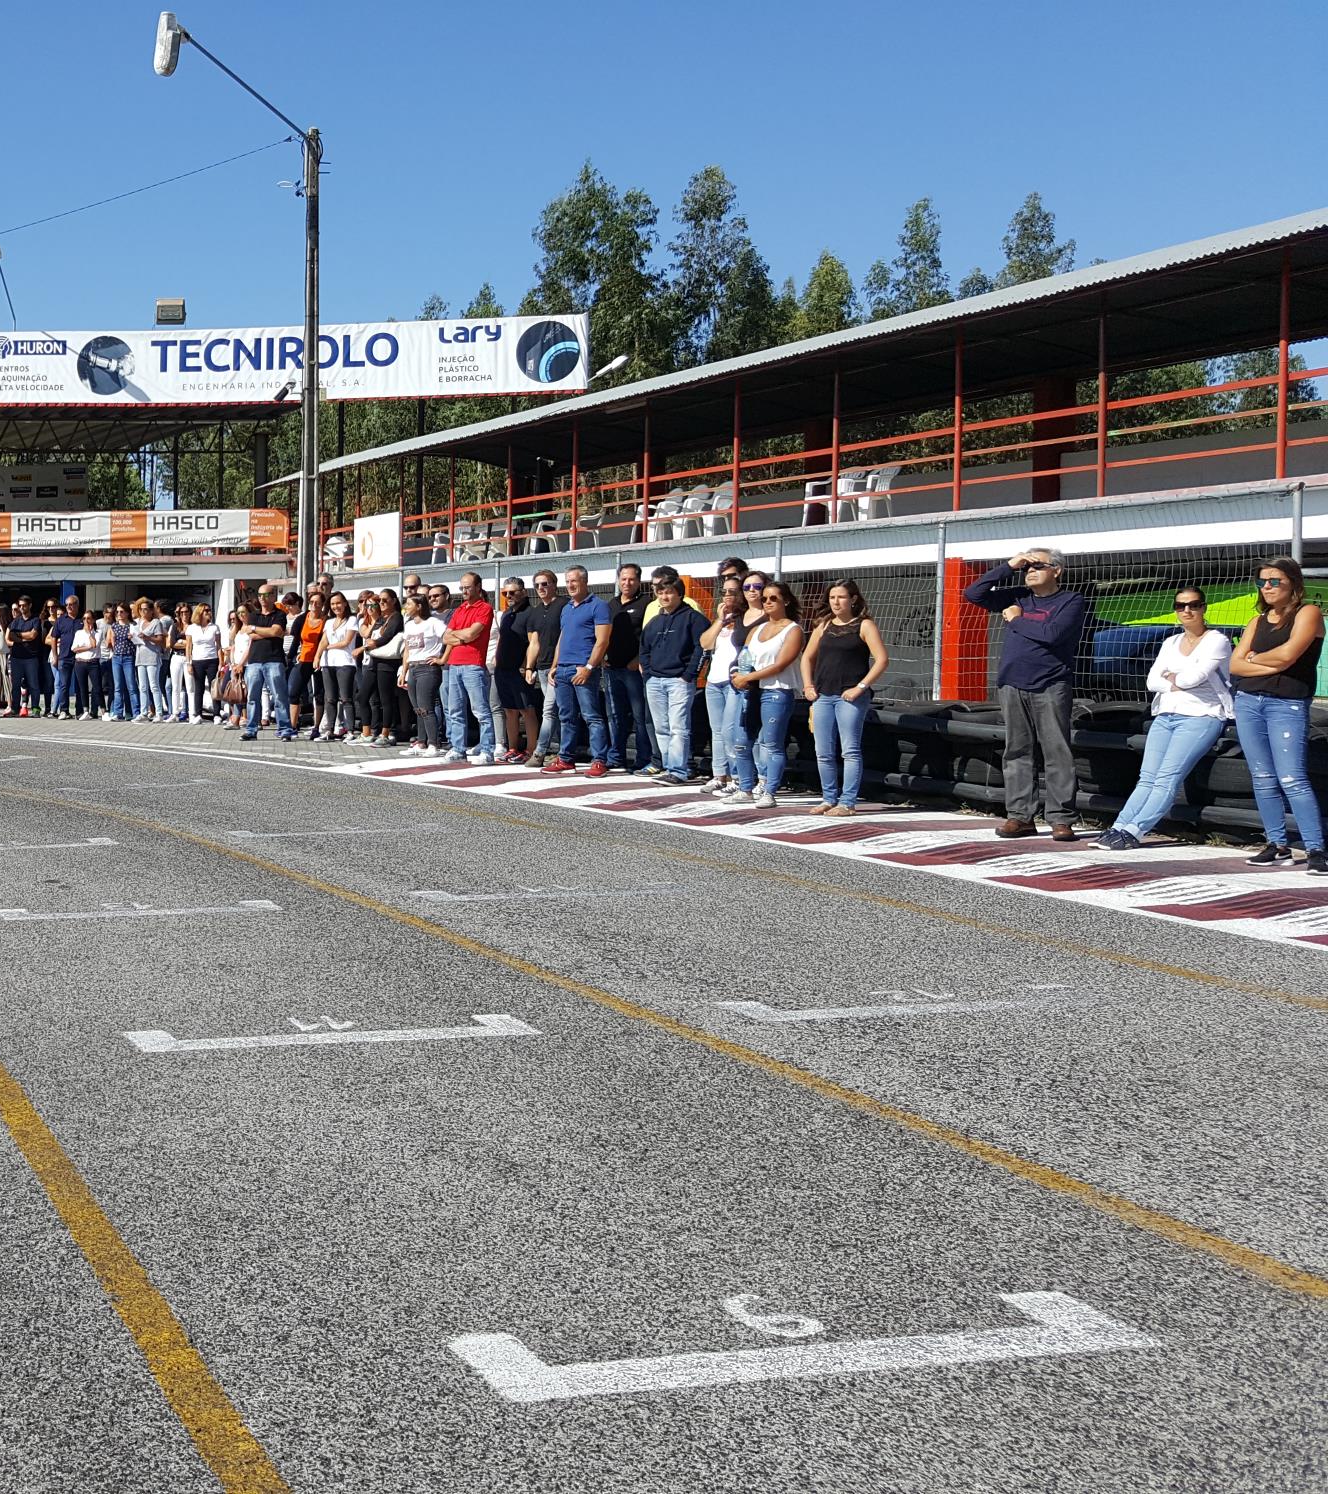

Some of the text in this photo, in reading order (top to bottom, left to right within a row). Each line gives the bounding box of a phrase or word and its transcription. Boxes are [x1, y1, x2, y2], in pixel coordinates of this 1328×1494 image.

[17, 341, 63, 354] HURON
[151, 332, 400, 373] TECNIROLO
[438, 354, 475, 364] INJEÇÃO
[438, 364, 479, 373] PLÁSTICO
[445, 374, 493, 383] BORRACHA
[182, 381, 256, 391] ENGENHARIA
[341, 378, 365, 387] S.A.
[17, 517, 82, 532] HASCO
[153, 515, 219, 530] HASCO
[17, 538, 52, 547] Enabling
[53, 538, 71, 546] with
[152, 537, 190, 546] Enabling
